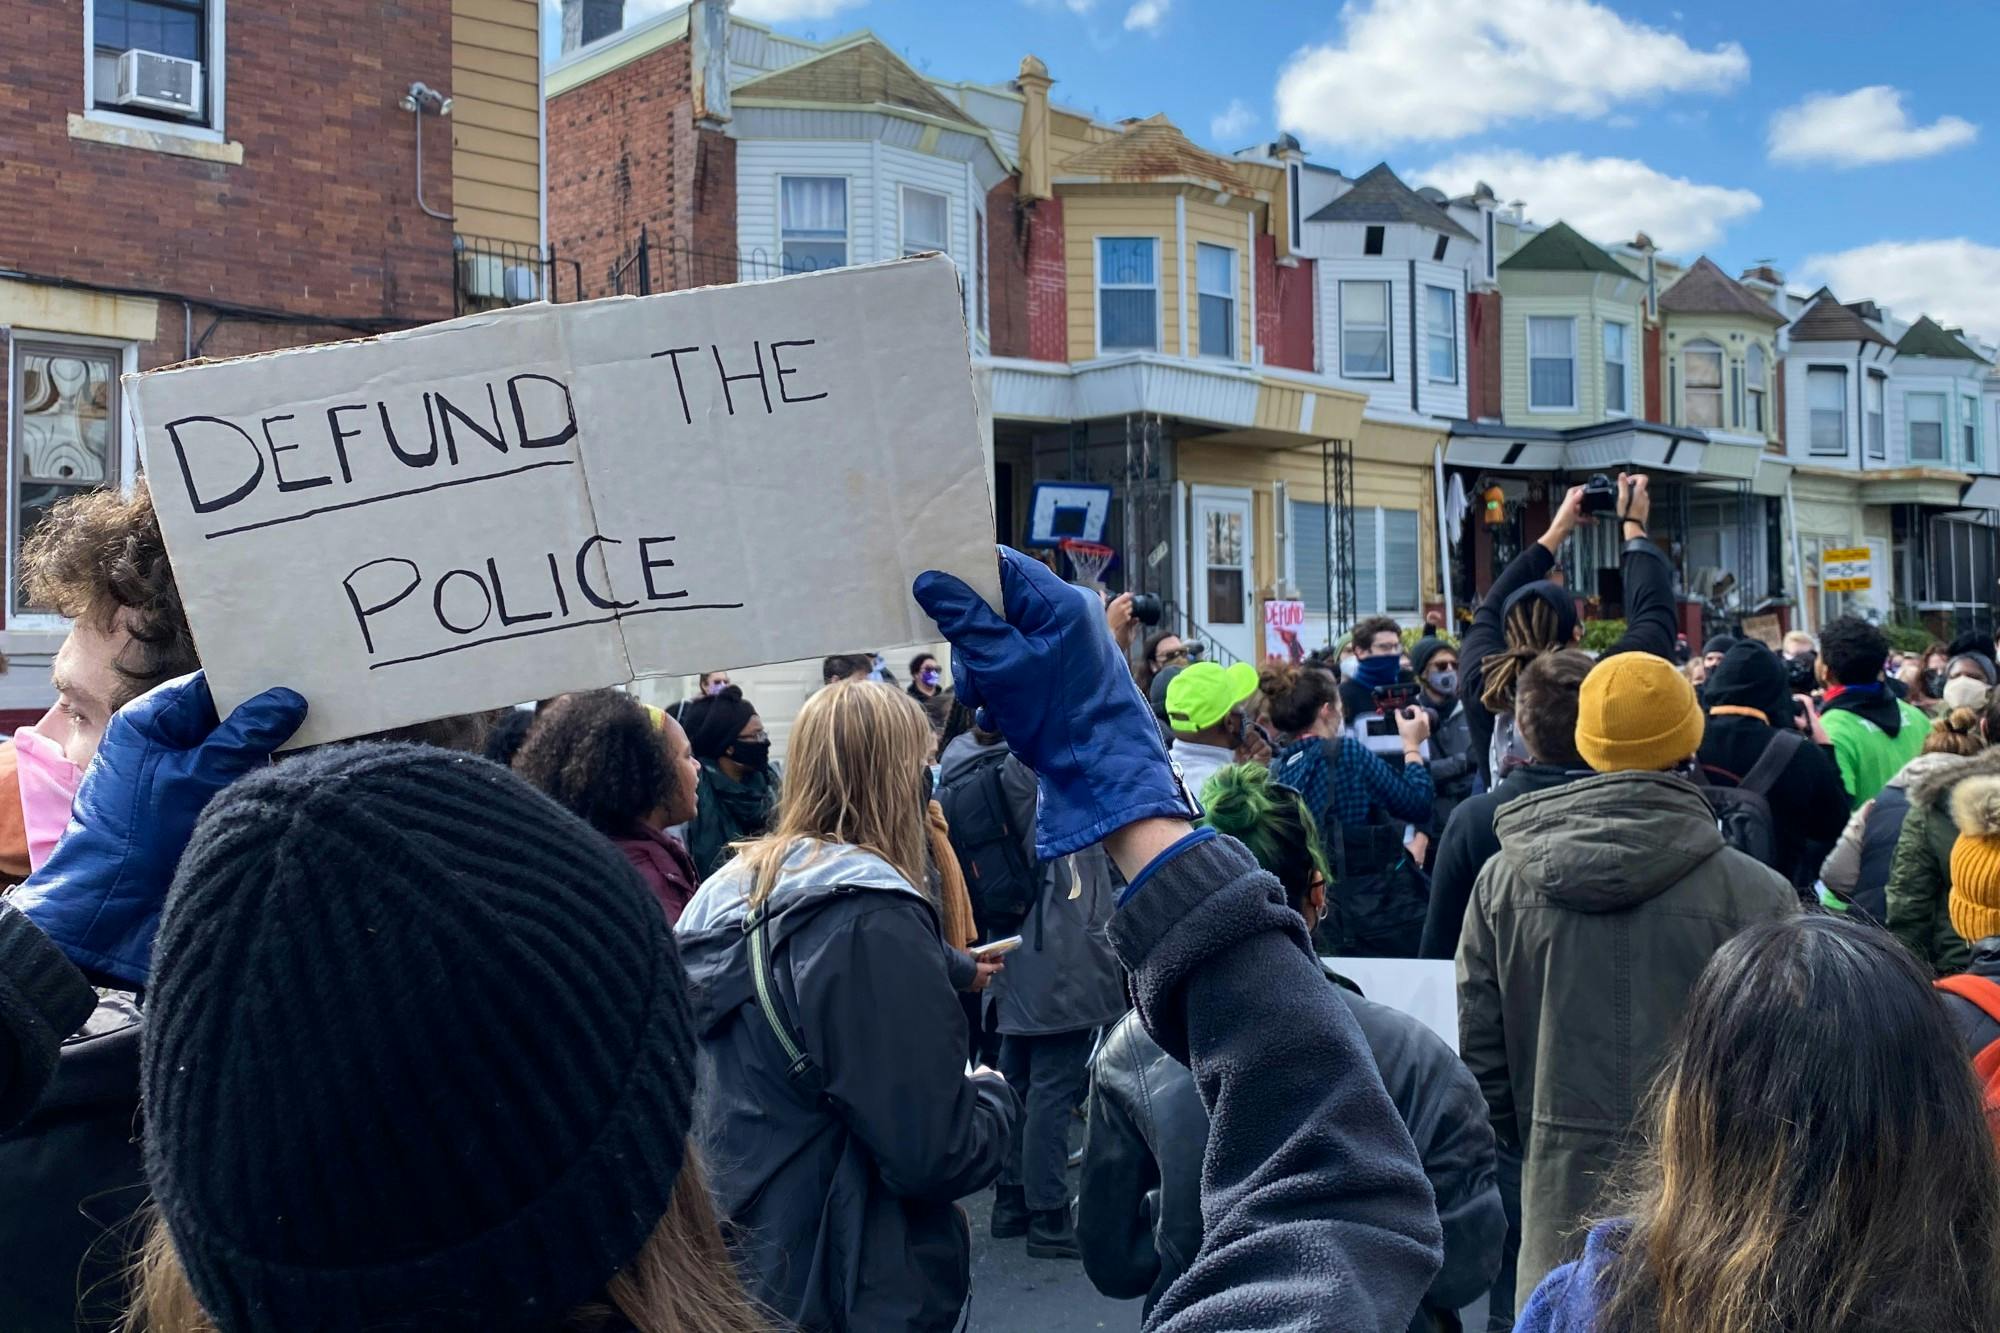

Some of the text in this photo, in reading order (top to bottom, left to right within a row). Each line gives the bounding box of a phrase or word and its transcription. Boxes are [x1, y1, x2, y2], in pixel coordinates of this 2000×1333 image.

[164, 340, 829, 514] DEFUND THE
[342, 534, 689, 654] POLICE
[1264, 602, 1304, 626] DEFUND
